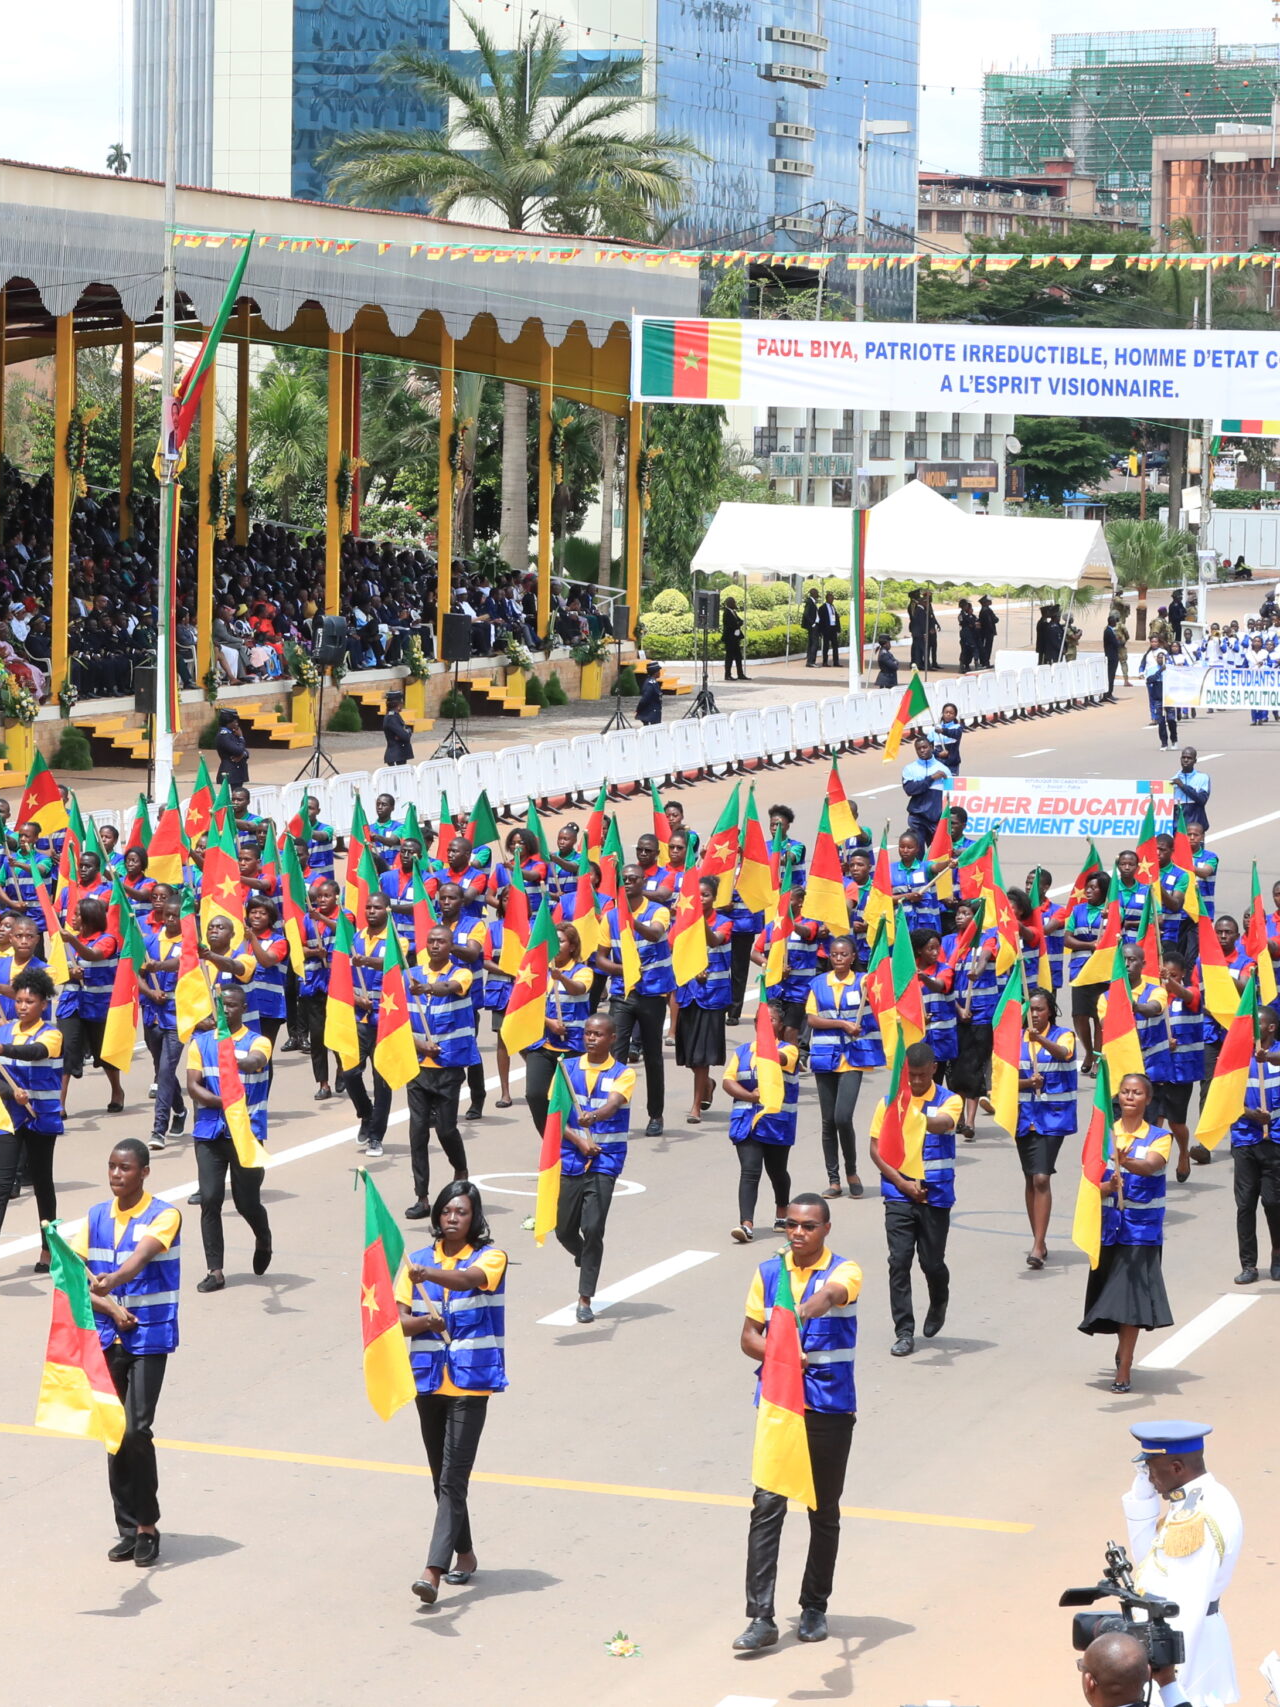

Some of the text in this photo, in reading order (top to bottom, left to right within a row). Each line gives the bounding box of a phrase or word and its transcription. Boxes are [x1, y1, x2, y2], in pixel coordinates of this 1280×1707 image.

[756, 338, 804, 358] PAUL
[810, 339, 859, 362] BIYA,
[865, 341, 956, 362] PATRIOTE
[962, 344, 1109, 369] IRREDUCTIBLE,
[1114, 348, 1187, 367] HOMME
[1265, 351, 1280, 370] C
[940, 375, 954, 392] A
[1049, 378, 1179, 398] VISIONNAIRE.
[1214, 669, 1229, 686] LES
[1231, 670, 1275, 687] ETUDIANTS
[1206, 690, 1228, 705] DANS
[1231, 691, 1241, 705] SA
[942, 796, 1175, 816] HIGHER EDUCATION
[963, 817, 1174, 836] SEIGNEMENT SUPERIUR
